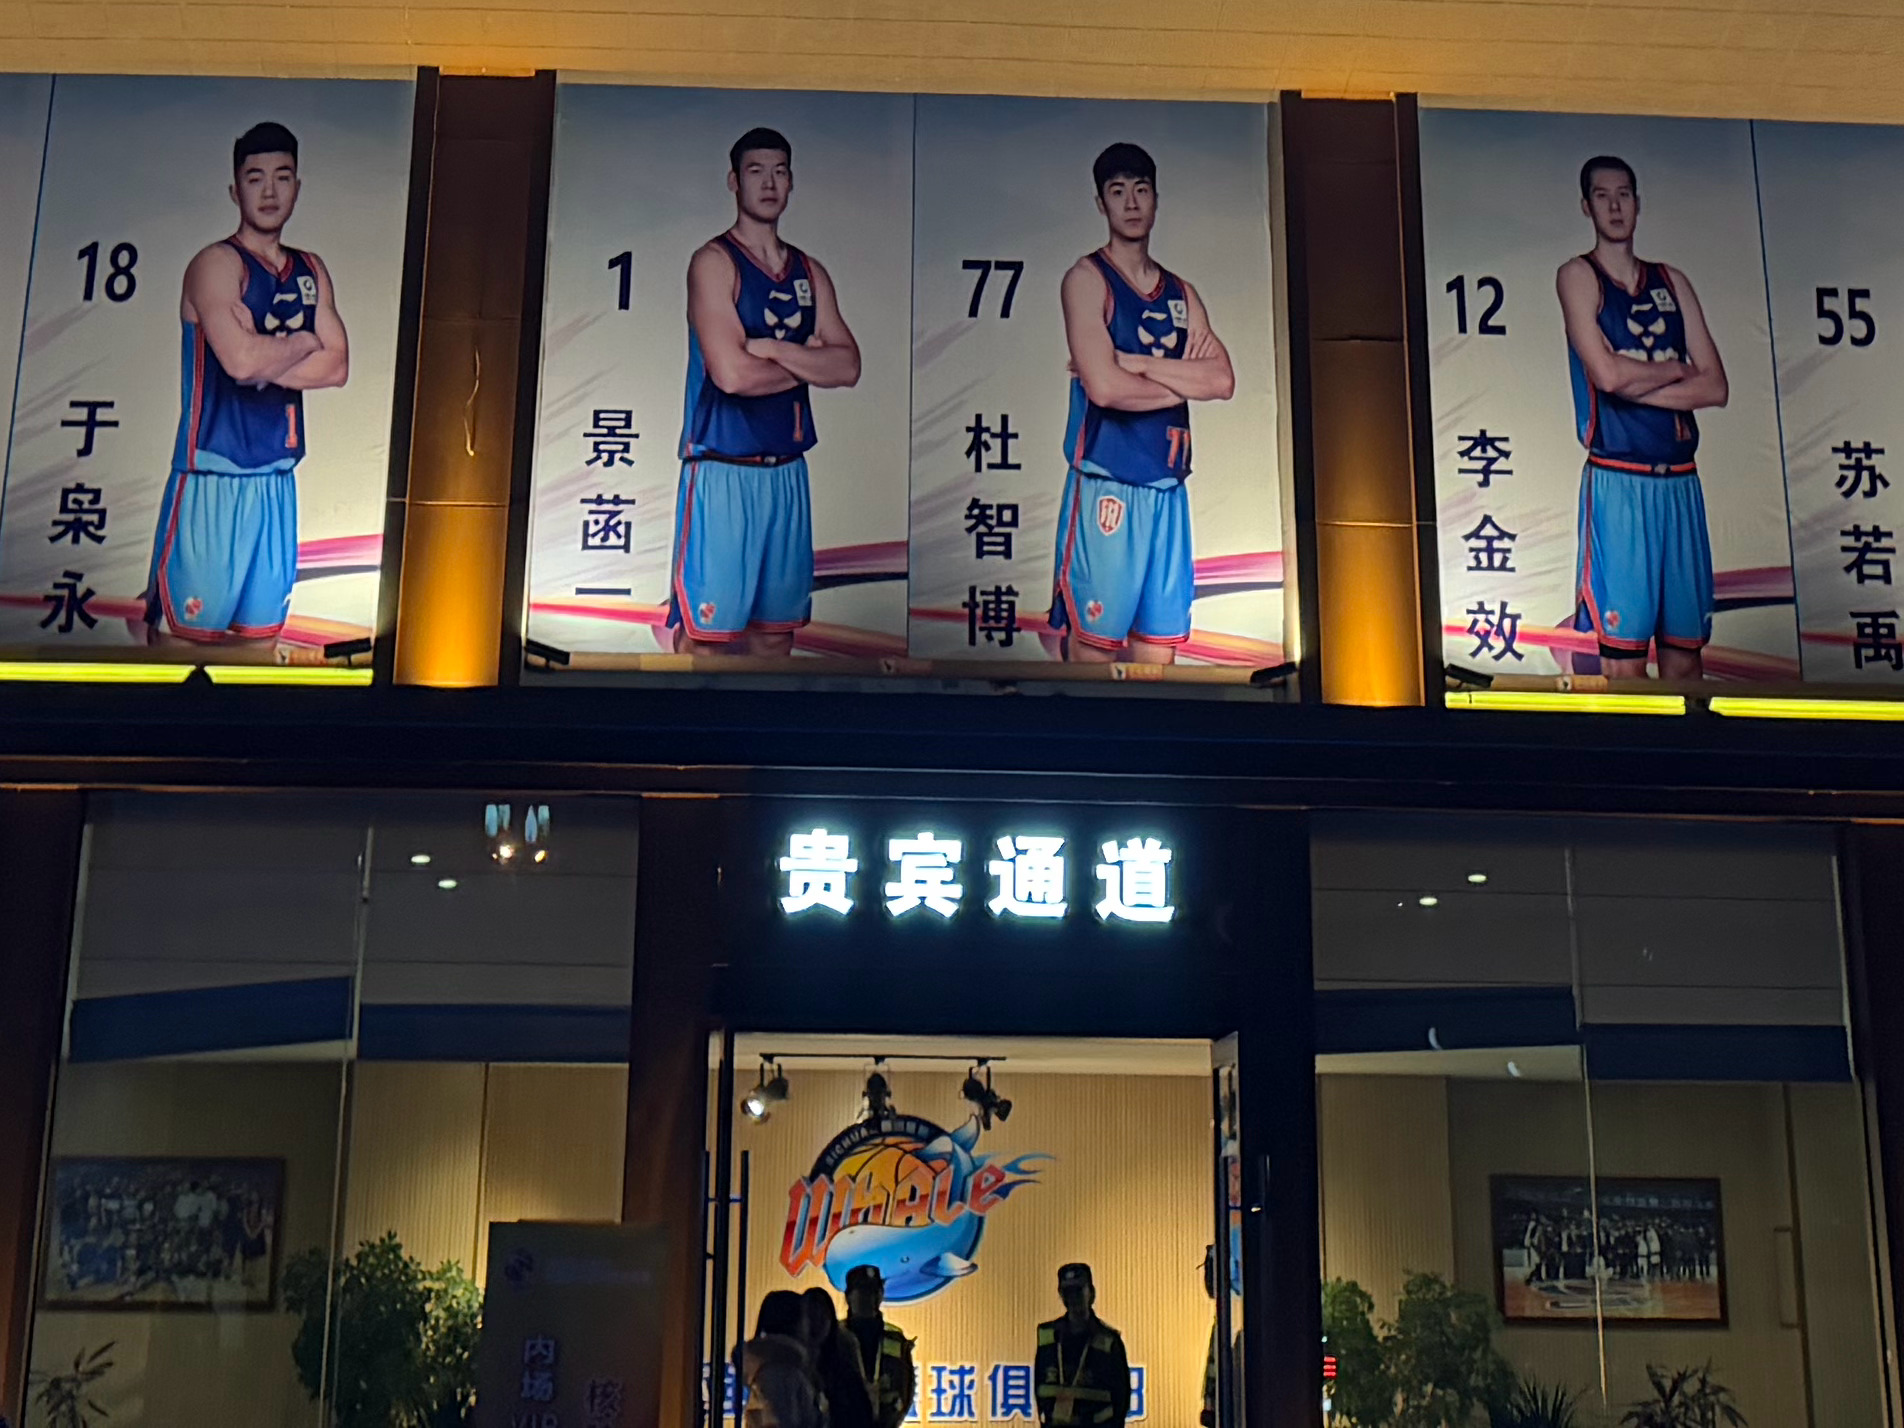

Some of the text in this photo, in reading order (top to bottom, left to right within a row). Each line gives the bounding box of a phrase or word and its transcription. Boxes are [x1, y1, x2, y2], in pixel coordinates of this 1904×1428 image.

[76, 241, 138, 303] 18
[607, 251, 633, 311] 1
[961, 260, 1024, 320] 77
[1444, 274, 1507, 336] 12
[1814, 287, 1876, 347] 55
[40, 401, 119, 633] 于枭永
[574, 409, 640, 597] 景菡一
[961, 413, 1022, 647] 杜智博
[1456, 429, 1525, 662] 李金效
[1831, 441, 1904, 670] 苏若禹
[779, 828, 1176, 923] 贵宾通道
